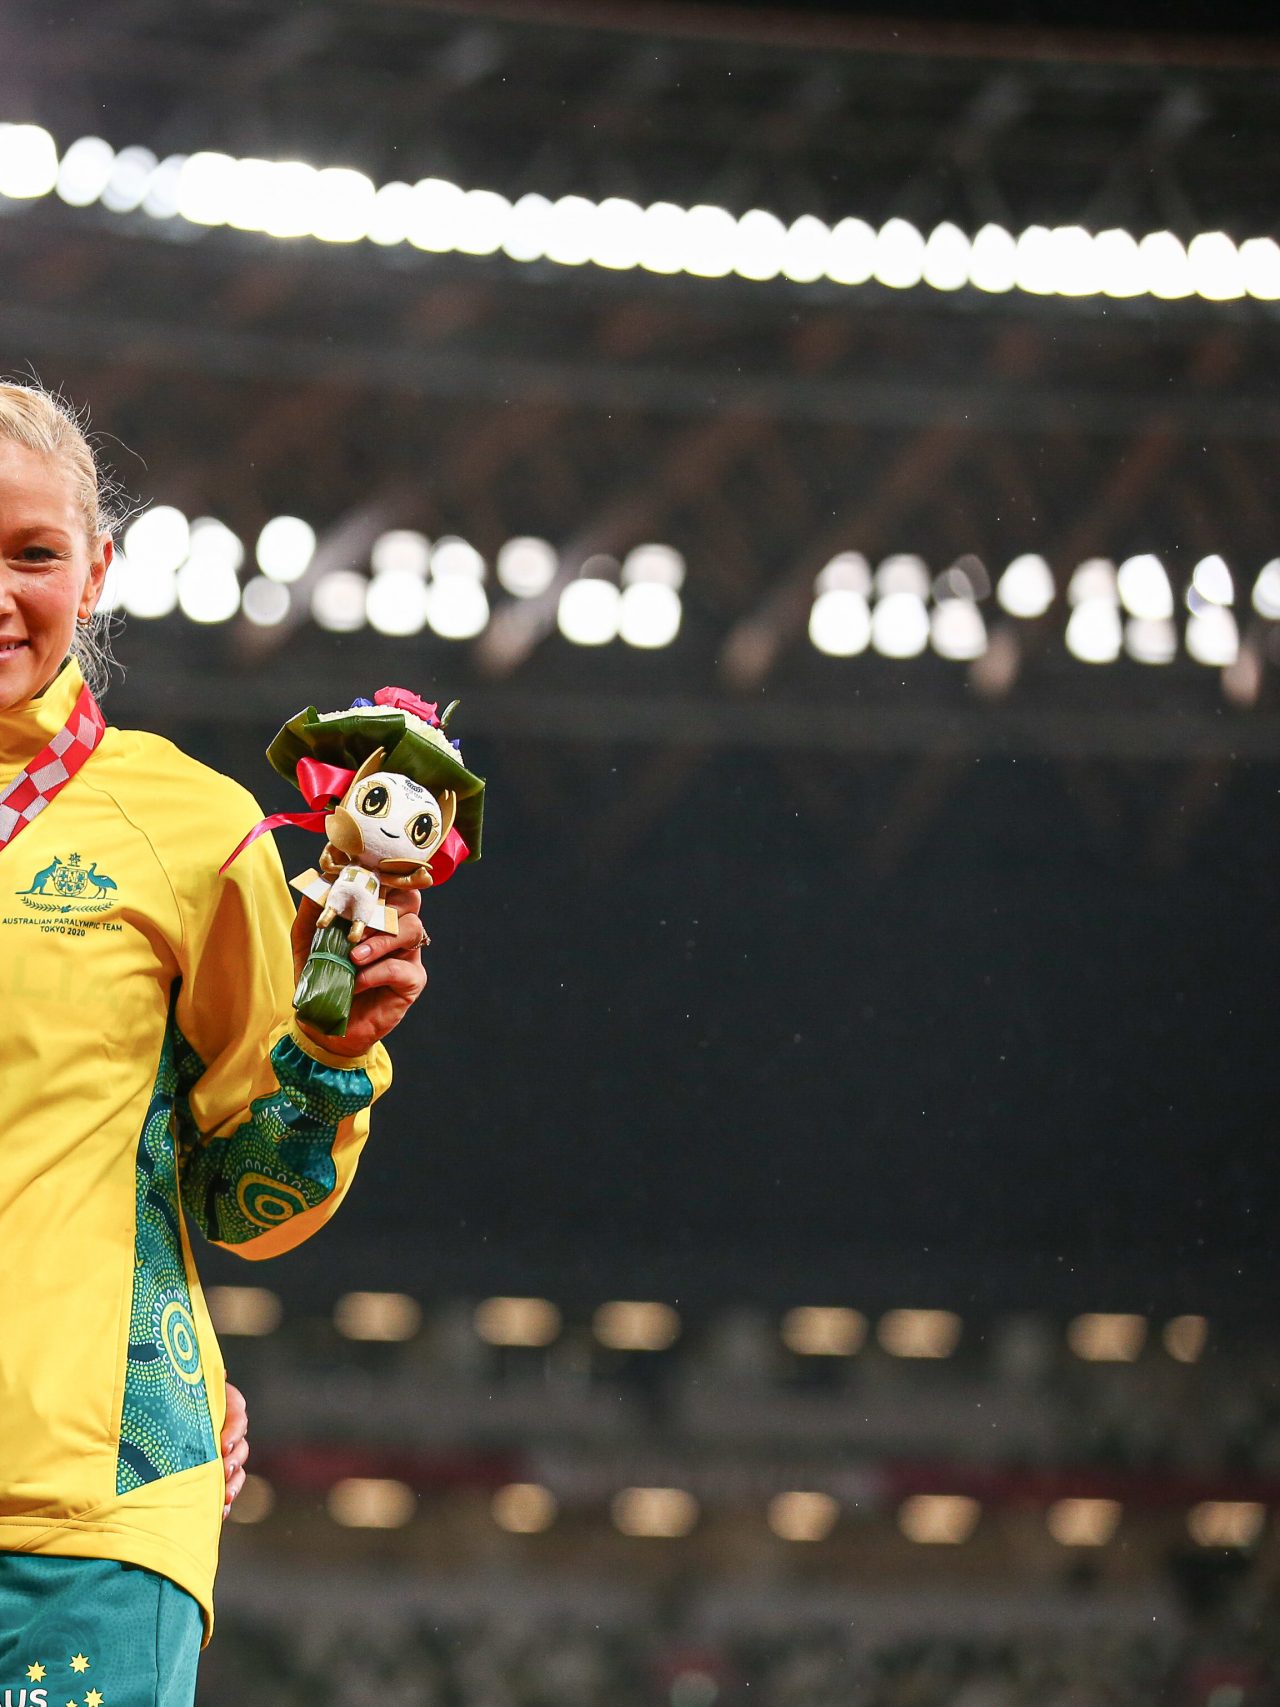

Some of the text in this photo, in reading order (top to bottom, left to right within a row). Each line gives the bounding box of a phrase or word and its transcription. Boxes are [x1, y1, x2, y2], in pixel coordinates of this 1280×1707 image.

[1, 917, 123, 932] AUSTRALIAN PARALYMPIC TEAM
[40, 925, 86, 937] TOKYO 2020
